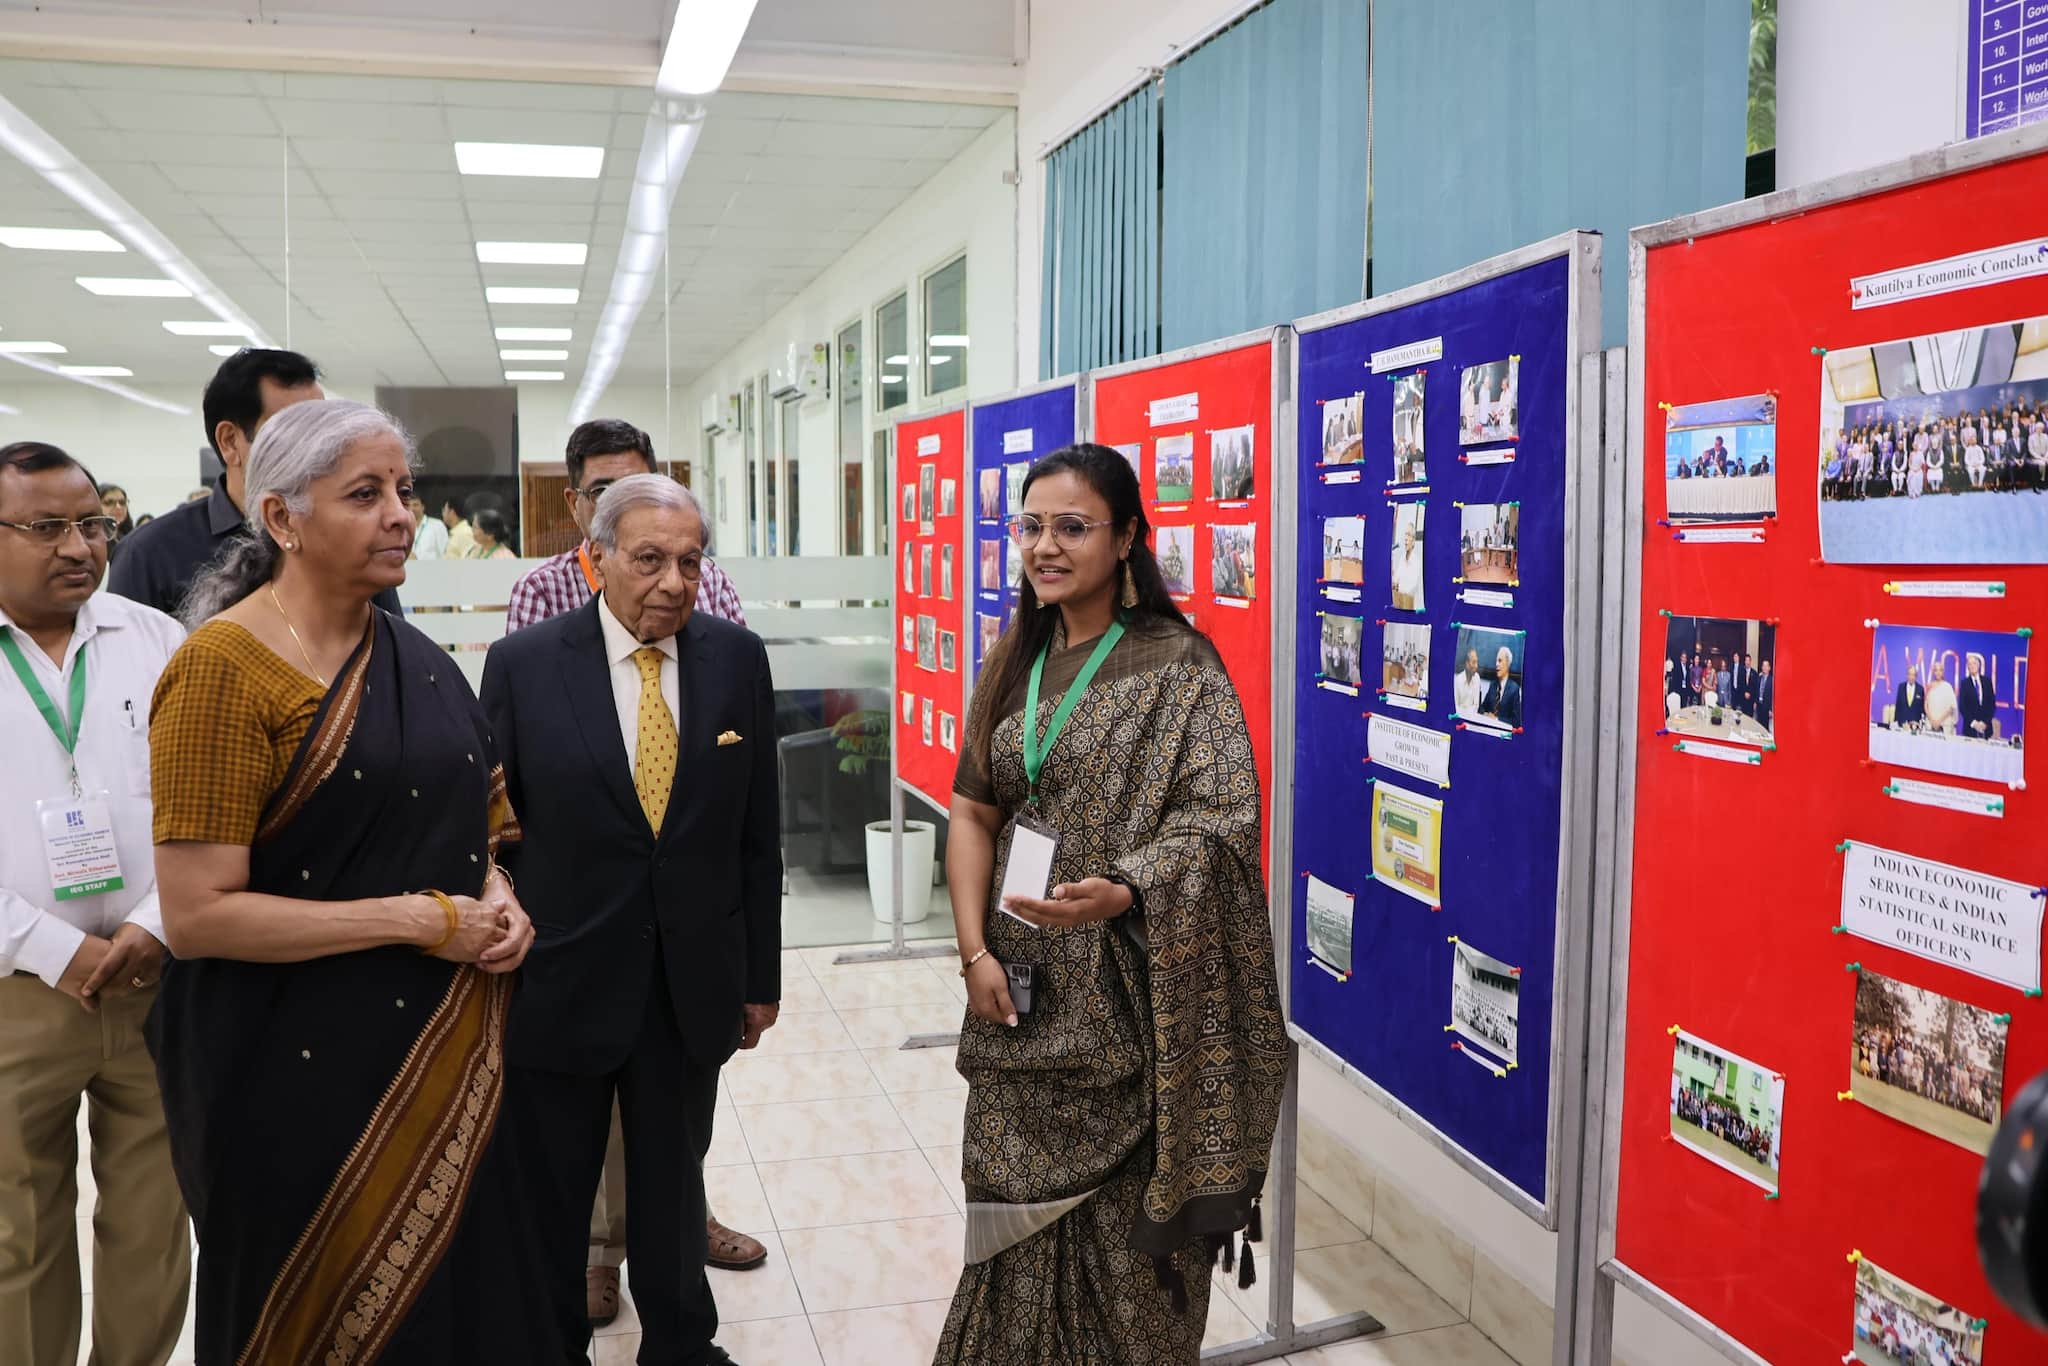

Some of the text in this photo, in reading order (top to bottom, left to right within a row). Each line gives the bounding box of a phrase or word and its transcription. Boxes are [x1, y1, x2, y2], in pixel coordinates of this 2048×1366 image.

[1994, 45, 2007, 59] 10.
[1993, 73, 2006, 87] 11.
[1865, 251, 2045, 297] Kautilya Economic Conclave
[85, 881, 108, 891] STAFF
[1873, 854, 2008, 902] INDIAN ECONOMIC
[1869, 876, 2008, 926] SERVICES & INDIAN
[1858, 894, 2018, 955] STATISTICAL SERVICE
[1896, 928, 1972, 963] OFFICER'S
